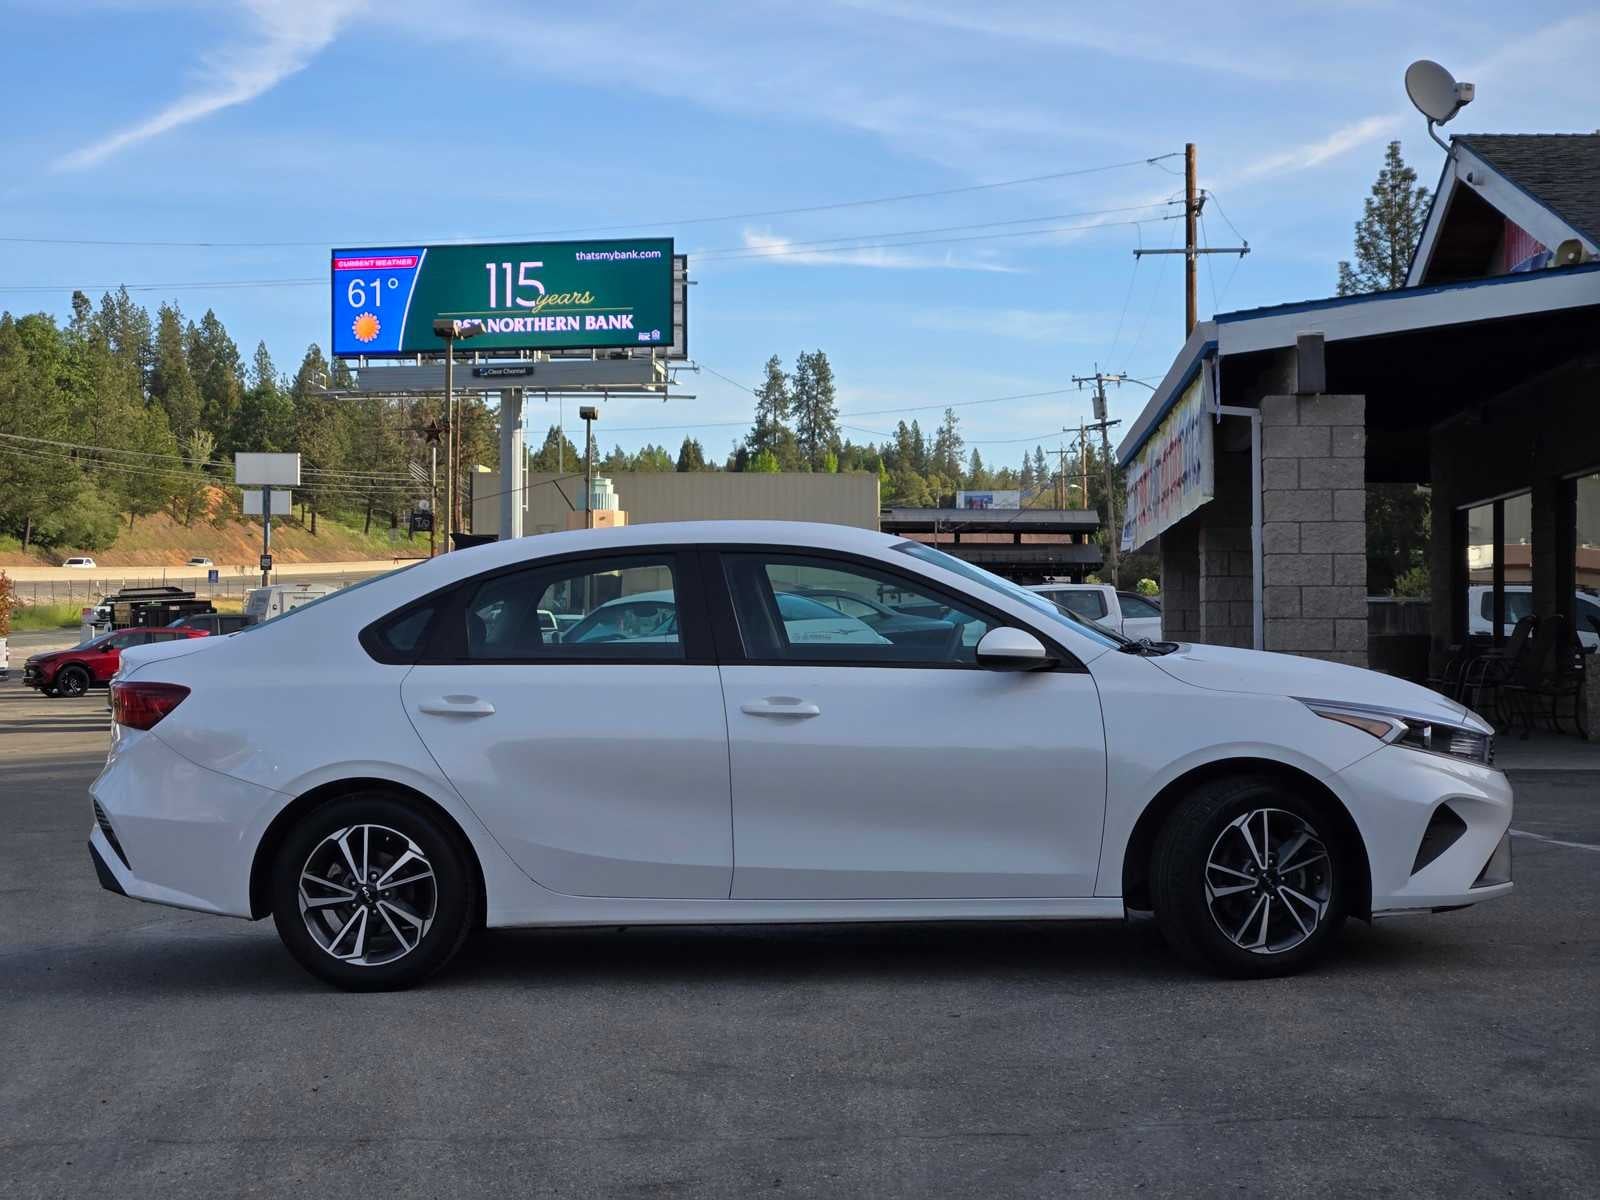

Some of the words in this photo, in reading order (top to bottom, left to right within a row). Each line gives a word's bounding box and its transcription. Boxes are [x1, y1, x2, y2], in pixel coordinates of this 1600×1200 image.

[575, 249, 662, 261] thatsmybank.com
[485, 261, 546, 308] 115
[531, 291, 595, 314] years
[486, 316, 581, 333] NORTHERN
[585, 314, 634, 331] BANK
